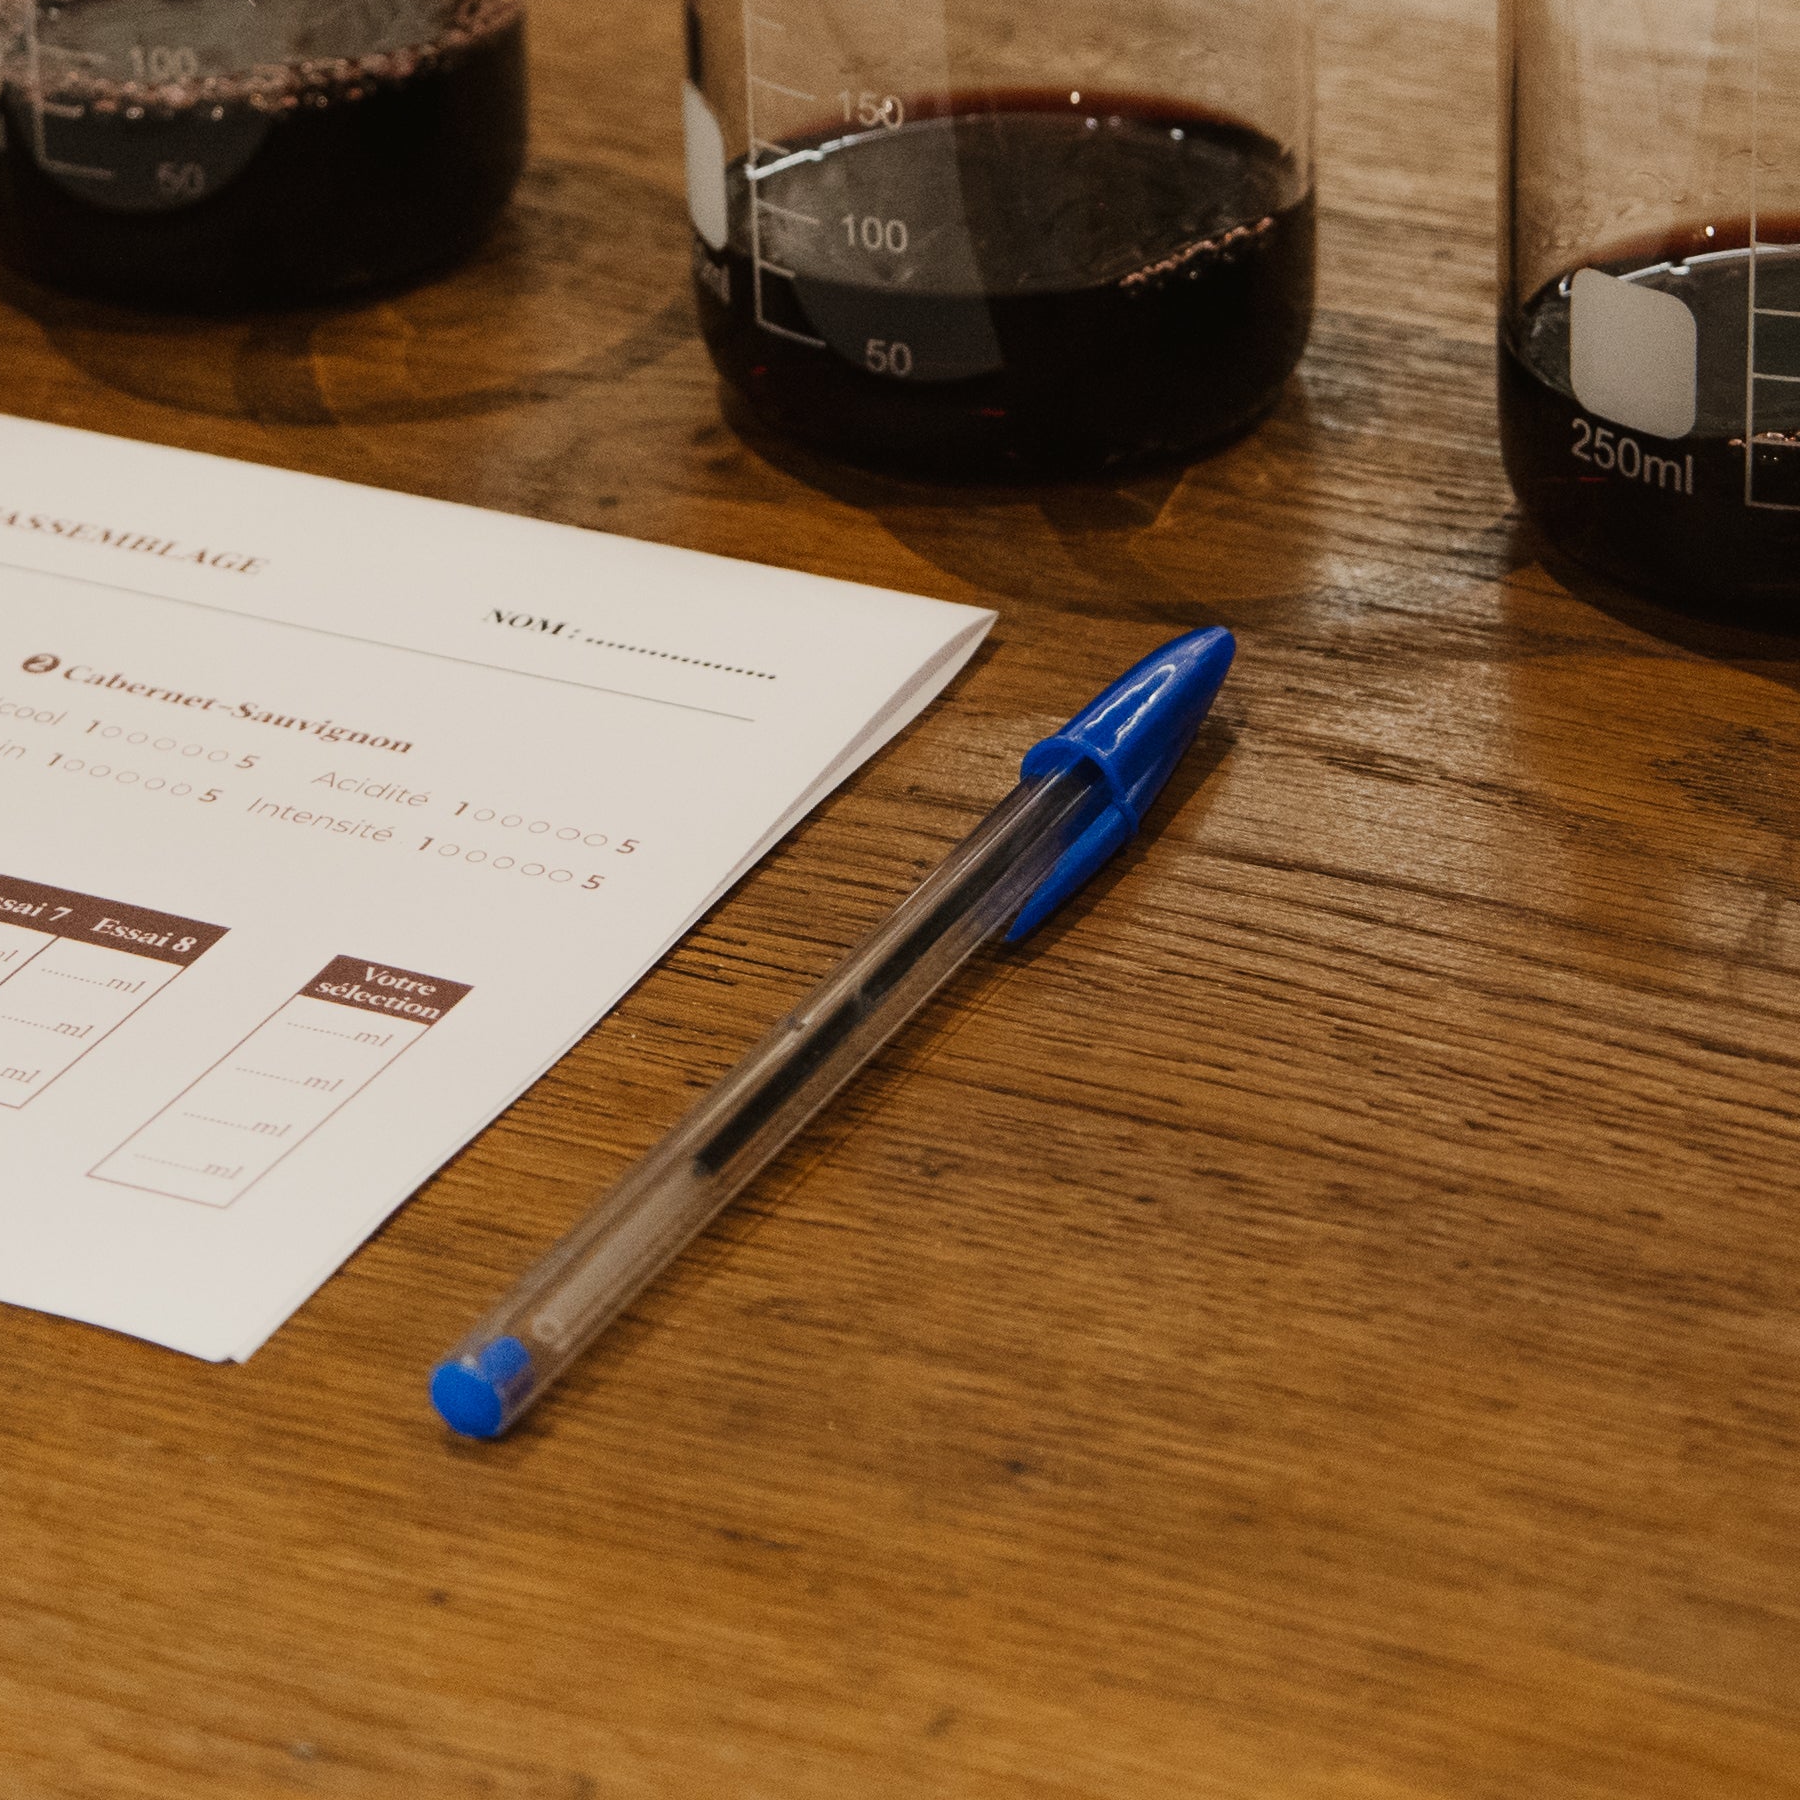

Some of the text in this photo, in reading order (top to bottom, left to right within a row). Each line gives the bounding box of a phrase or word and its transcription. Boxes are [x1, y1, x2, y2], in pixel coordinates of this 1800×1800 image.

[838, 89, 904, 130] 150
[842, 213, 907, 254] 100
[865, 337, 912, 376] 50
[1571, 417, 1694, 495] 250ml
[63, 665, 414, 753] Cabernet-Sauvignon
[311, 770, 432, 807] Acidité
[247, 797, 396, 843] Intensité
[44, 907, 73, 922] 7
[90, 917, 198, 954] Essai 8
[313, 978, 442, 1021] sélection
[364, 965, 438, 998] Votre
